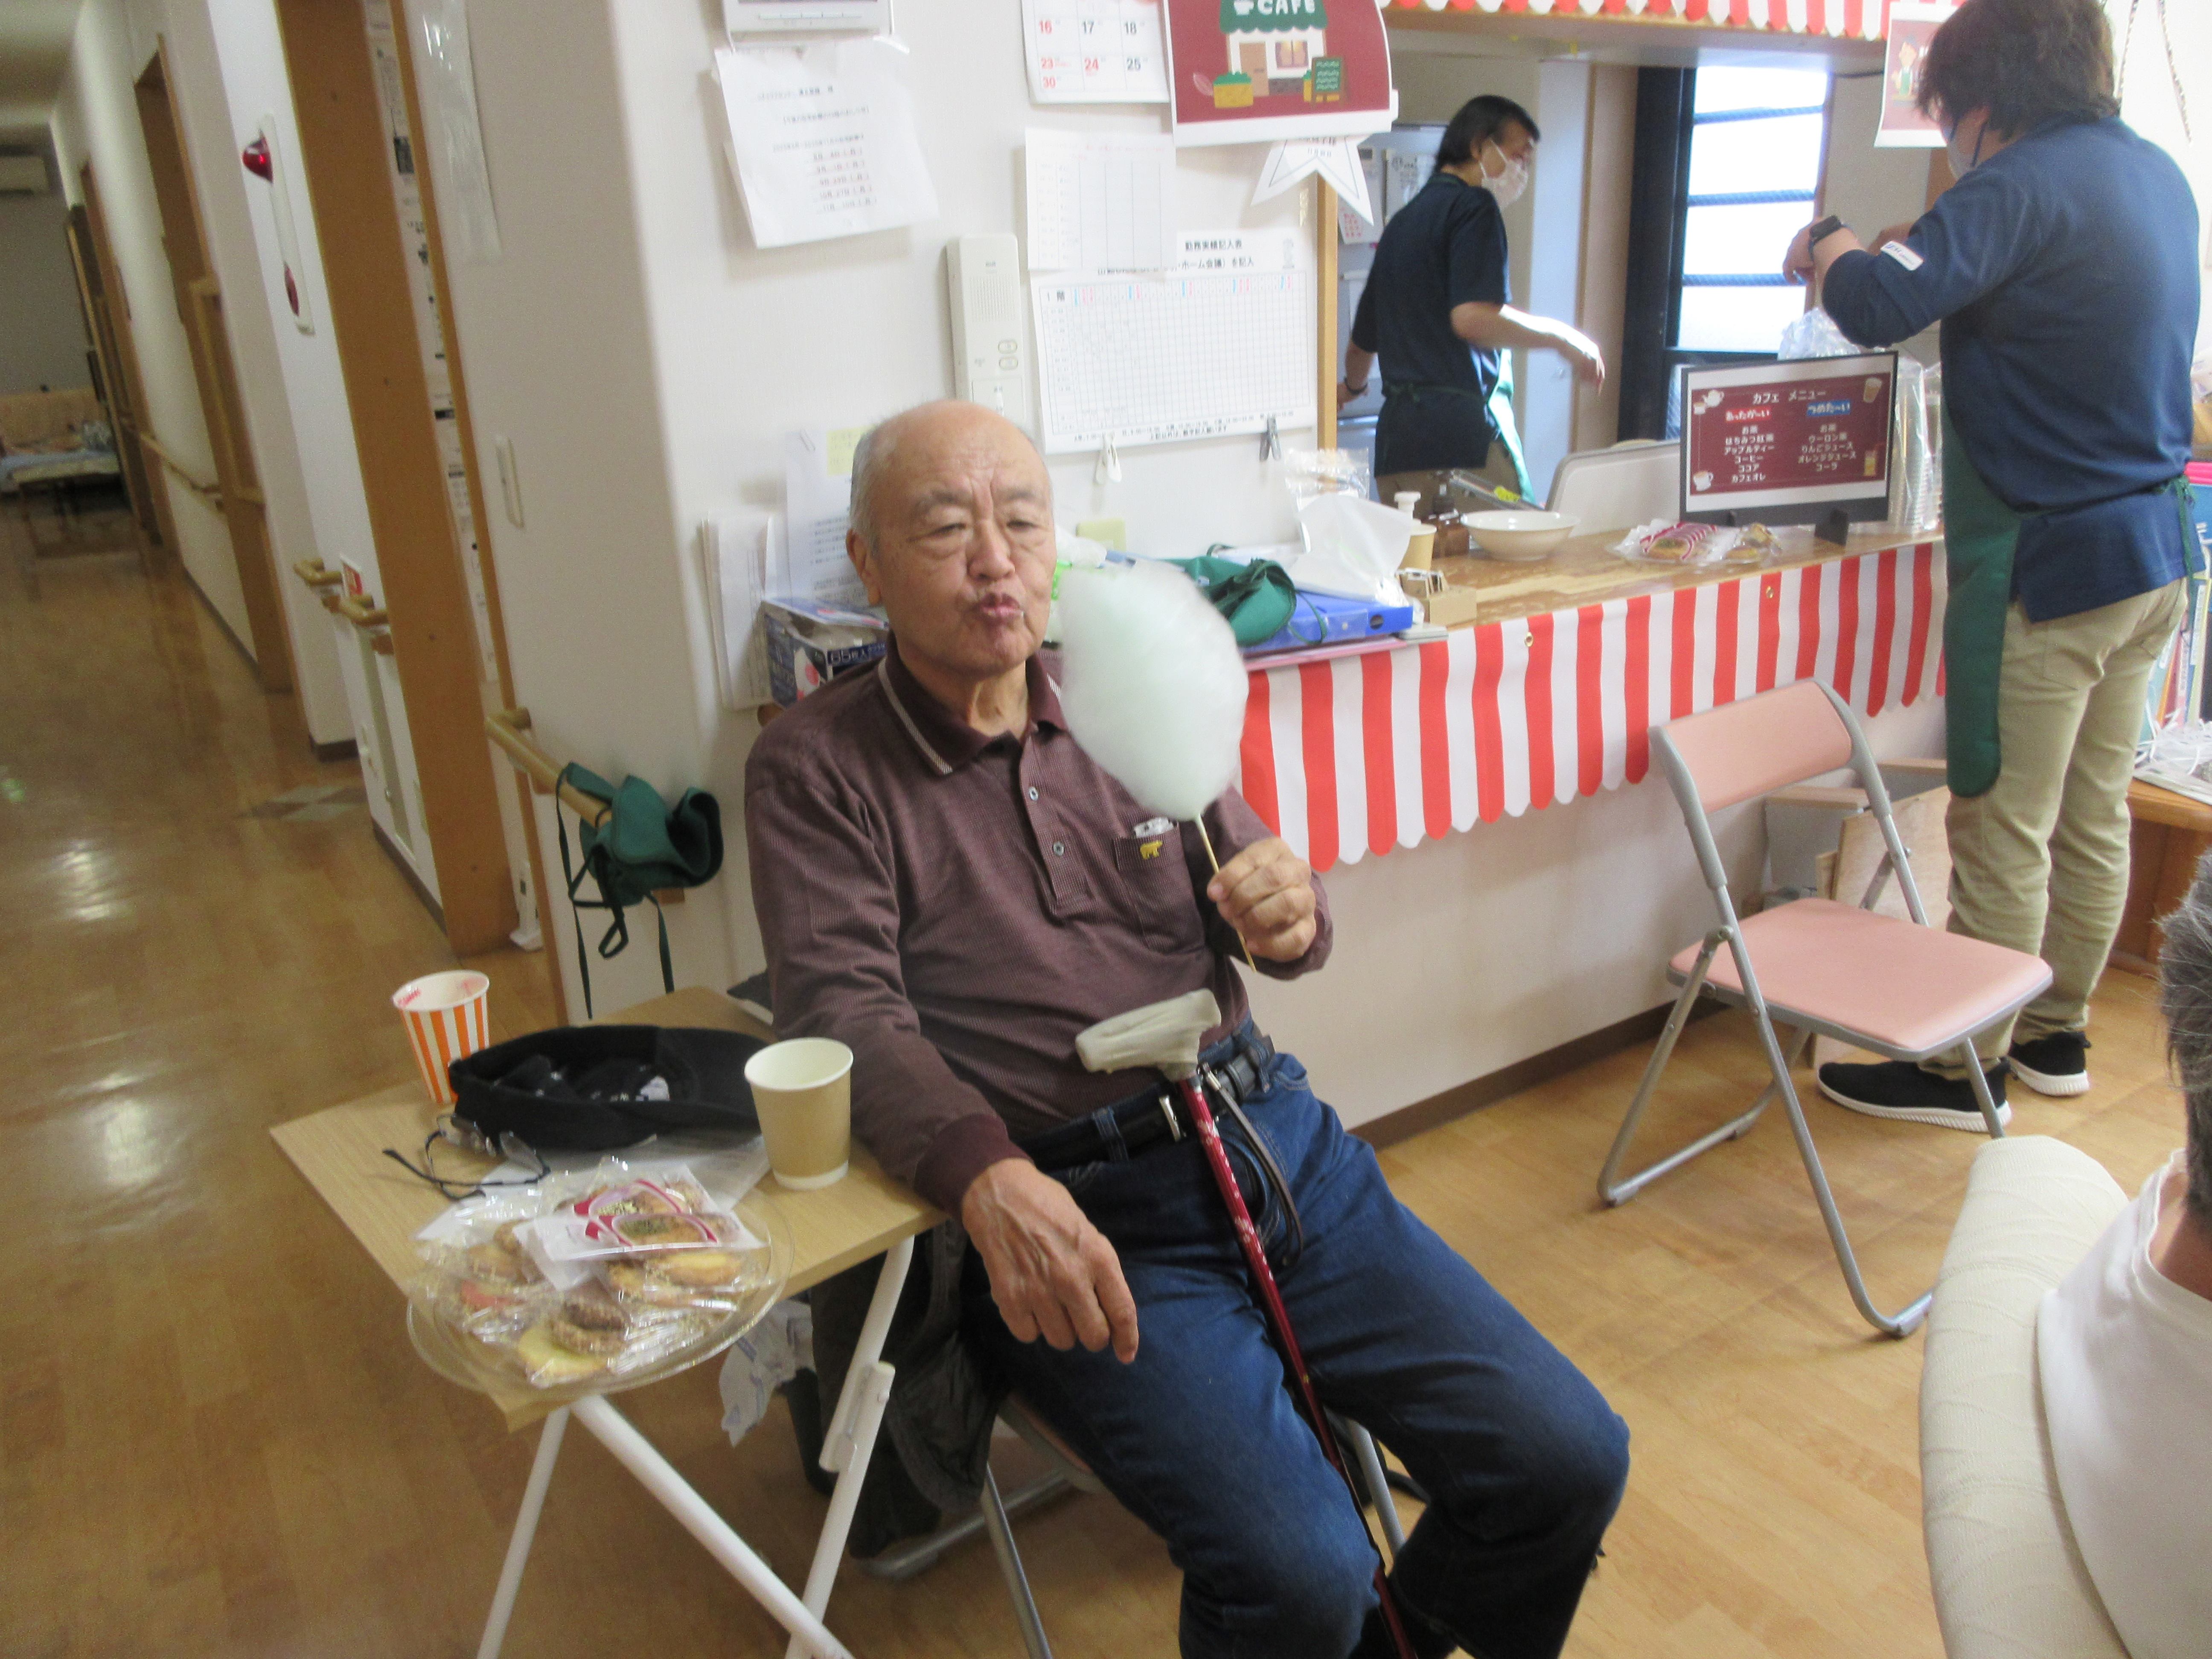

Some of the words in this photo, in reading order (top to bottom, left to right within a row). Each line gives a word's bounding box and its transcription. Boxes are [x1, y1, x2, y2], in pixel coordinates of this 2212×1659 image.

[1039, 20, 1053, 34] 16
[1082, 20, 1094, 34] 17
[1124, 21, 1137, 35] 18
[1041, 57, 1054, 70] 23
[1084, 58, 1099, 71] 24
[1126, 57, 1141, 70] 25
[1042, 76, 1056, 88] 30
[1752, 391, 1780, 404] カフェ
[1788, 390, 1826, 402] メニュー
[1724, 444, 1775, 455] アップルティー
[1735, 454, 1764, 464] コーヒー
[1798, 450, 1857, 464] オレンジジュース
[1738, 463, 1760, 473] ココア
[1816, 462, 1838, 472] コーラ
[1731, 472, 1766, 483] カフェオレ
